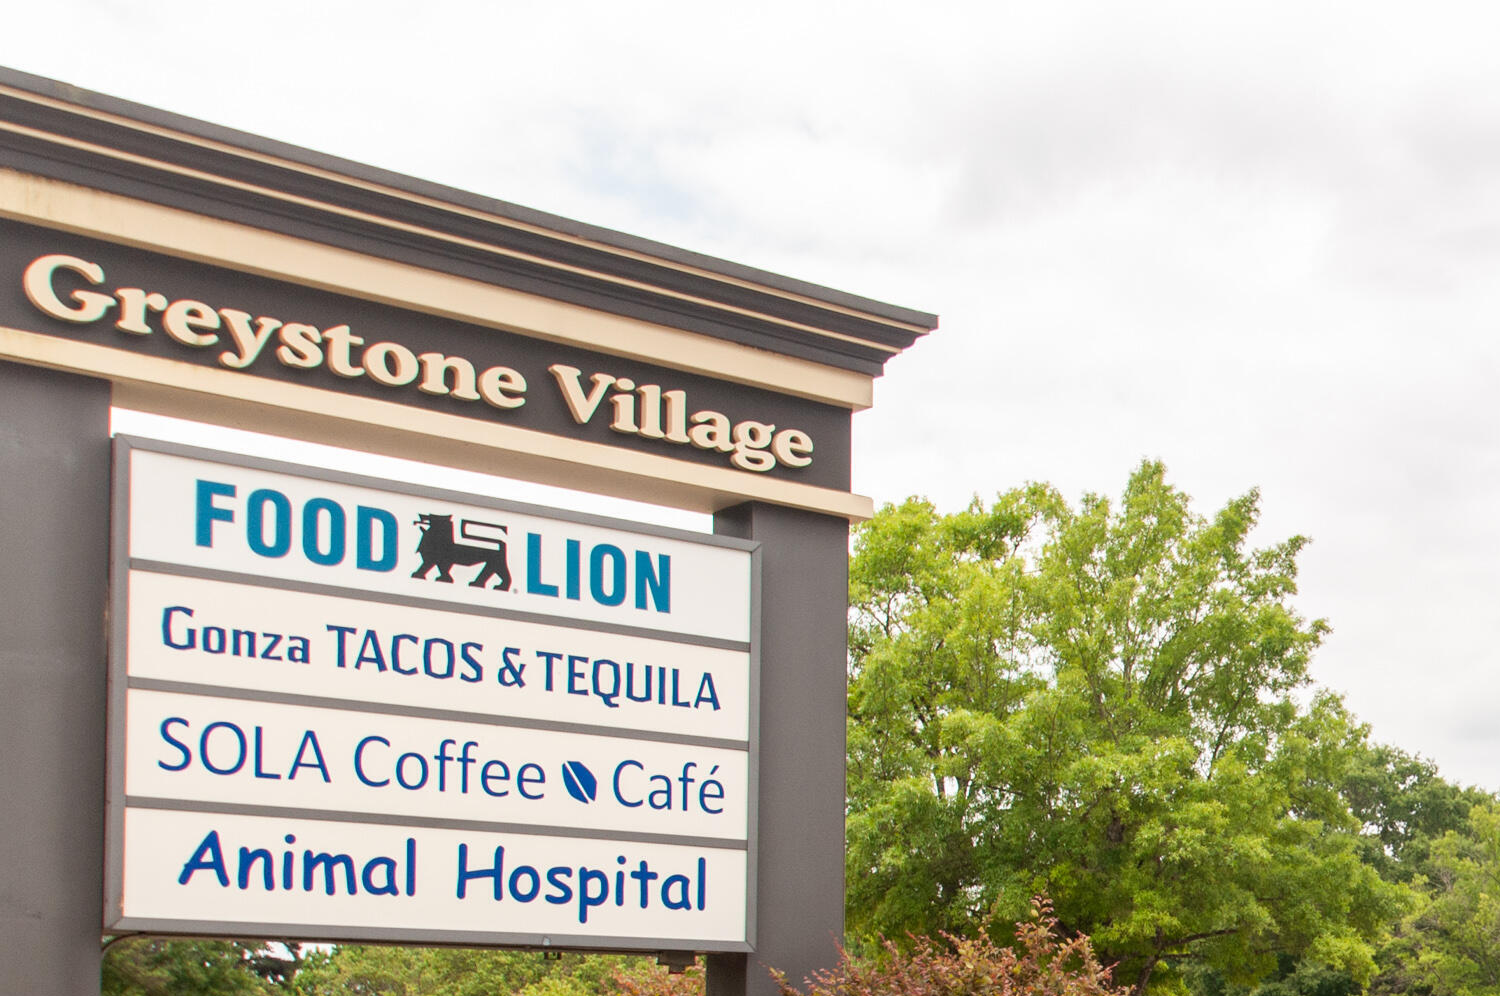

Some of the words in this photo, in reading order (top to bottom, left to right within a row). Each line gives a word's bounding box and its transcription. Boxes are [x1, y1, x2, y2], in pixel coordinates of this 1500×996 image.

[23, 255, 527, 410] Greystone
[548, 363, 815, 473] Village
[195, 479, 400, 574] FOOD
[526, 532, 673, 614] LION
[161, 605, 311, 666] Gonza
[326, 623, 485, 685] TACOS
[496, 647, 527, 690] &
[536, 651, 722, 713] TEQUILA
[156, 716, 332, 785] SOLA
[353, 736, 547, 801] Coffee
[611, 760, 726, 816] Café
[177, 830, 417, 899] Animal
[457, 845, 706, 924] Hospital
